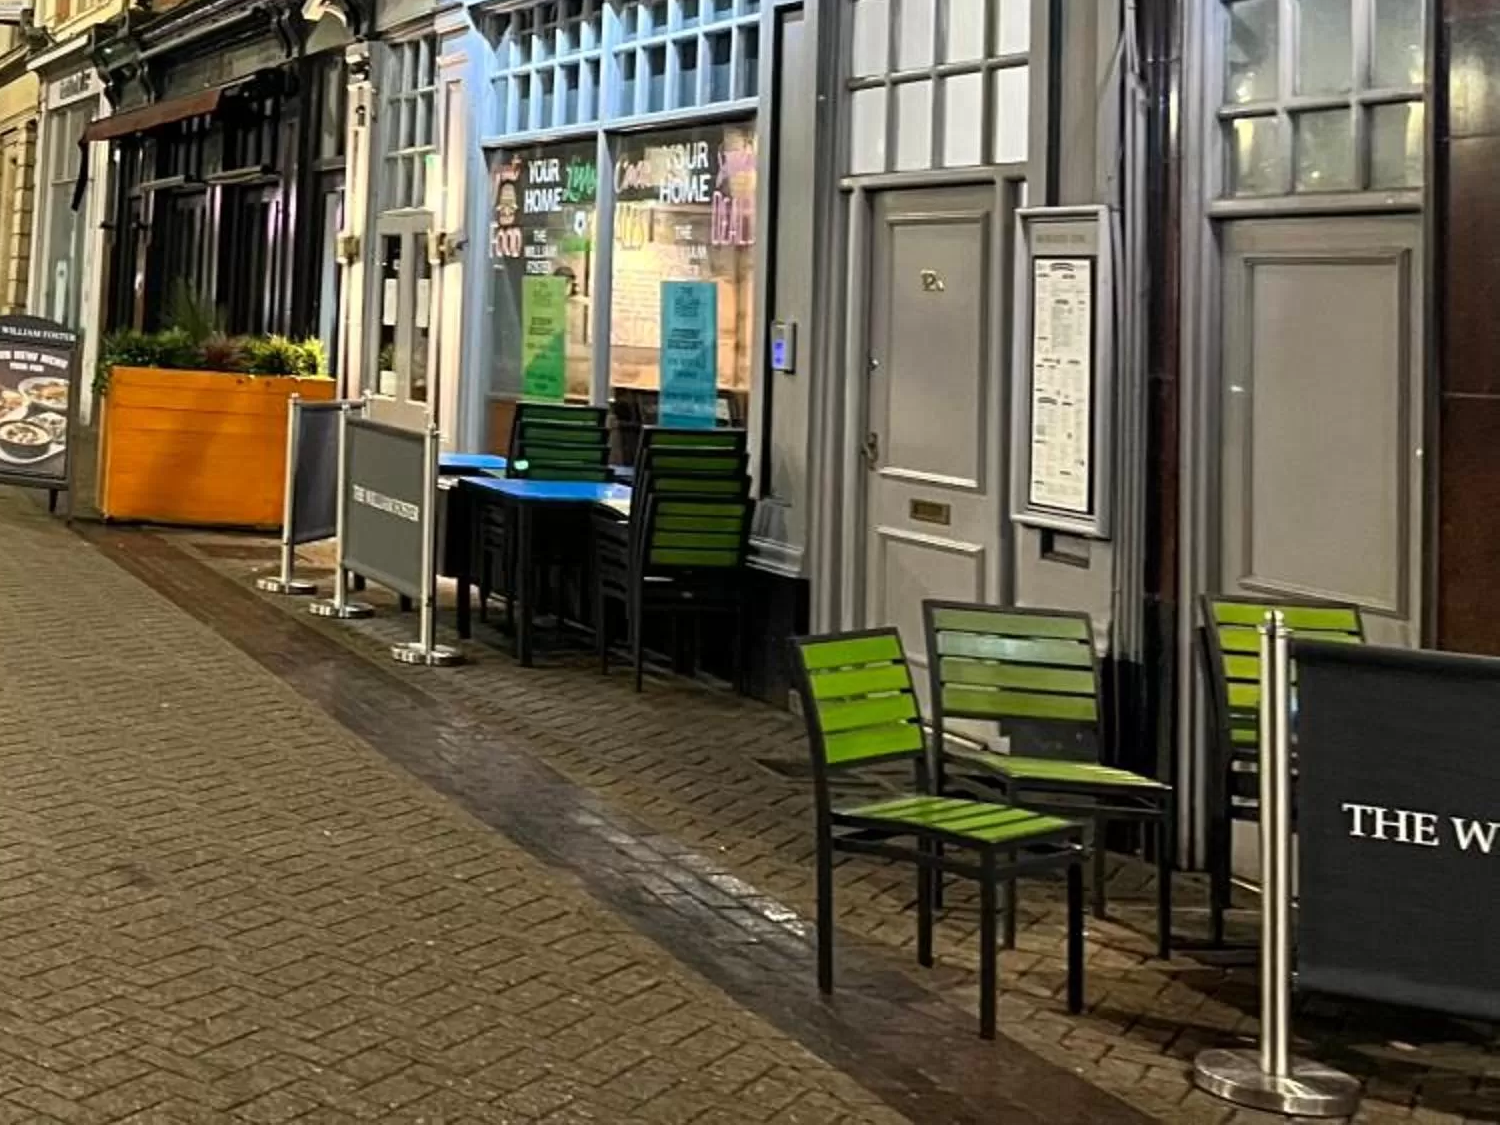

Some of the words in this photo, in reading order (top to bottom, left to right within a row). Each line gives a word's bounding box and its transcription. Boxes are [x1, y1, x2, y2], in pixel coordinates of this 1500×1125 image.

[528, 158, 560, 184] YOUR
[661, 141, 709, 171] YOUR
[524, 187, 563, 214] HOME
[659, 174, 712, 205] HOME
[1341, 802, 1440, 846] THE
